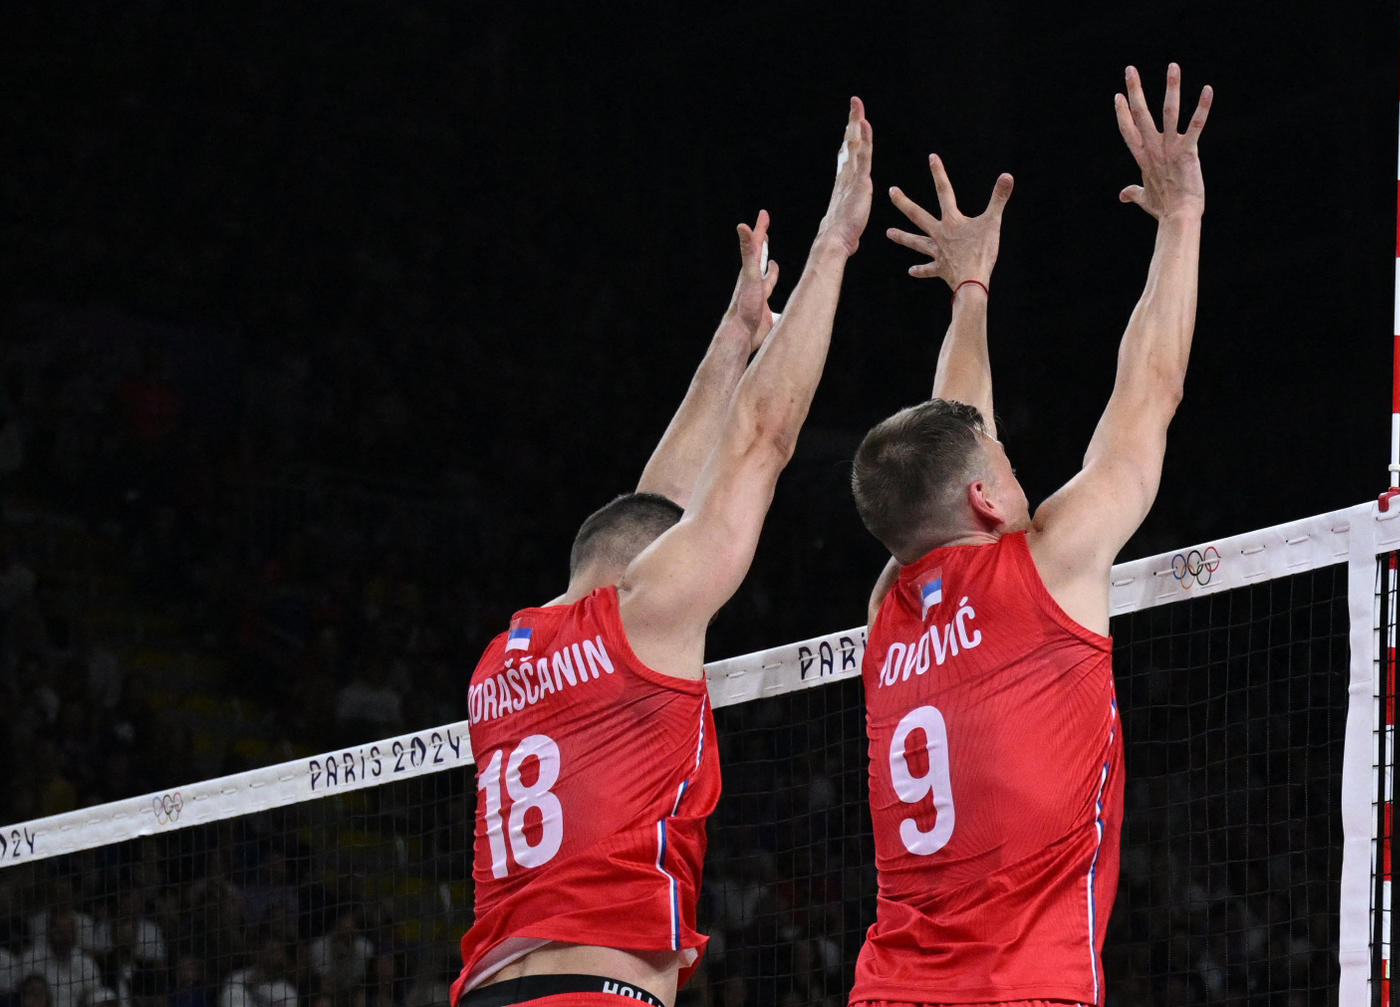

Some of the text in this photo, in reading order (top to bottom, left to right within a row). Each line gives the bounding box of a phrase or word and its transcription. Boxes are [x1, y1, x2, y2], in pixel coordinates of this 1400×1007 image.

[392, 729, 461, 772] 2024
[478, 734, 563, 879] 18
[889, 705, 955, 855] 9
